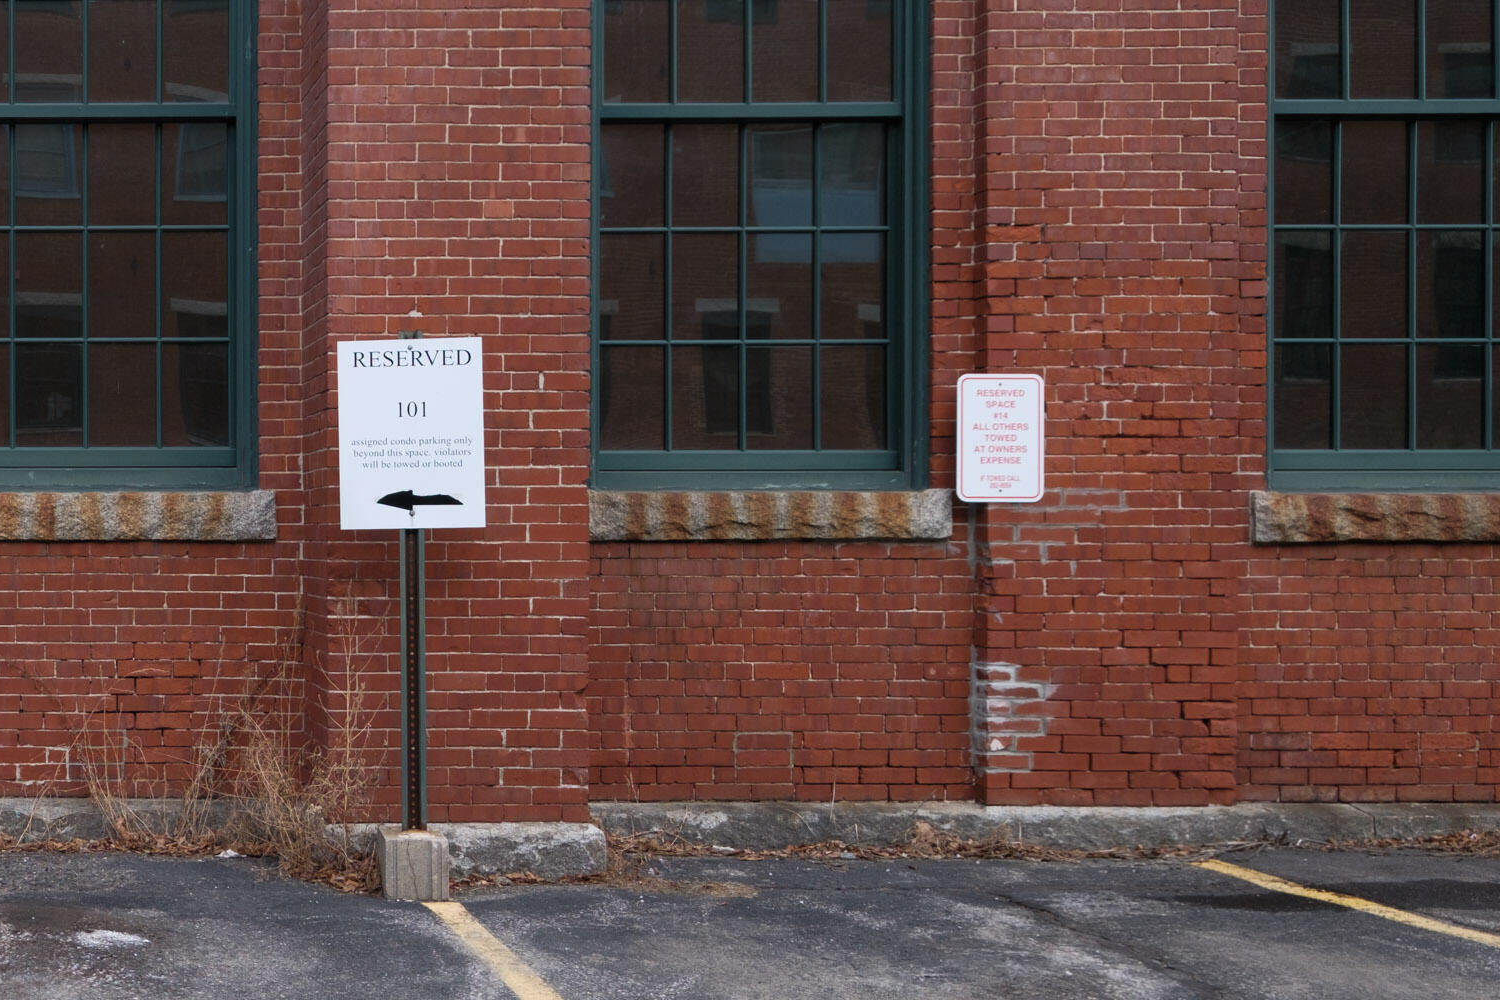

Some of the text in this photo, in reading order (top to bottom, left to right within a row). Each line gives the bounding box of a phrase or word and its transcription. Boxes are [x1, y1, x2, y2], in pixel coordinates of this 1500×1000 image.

[353, 349, 472, 368] RESERVED
[976, 389, 1026, 397] RESERVED
[985, 400, 1016, 408] SPACE
[397, 401, 428, 418] 101
[972, 423, 1029, 431] ALL OTHERS
[351, 436, 473, 448] assigned condo parking only
[984, 434, 1018, 442] TOWED
[973, 445, 1028, 453] AT OWNERS
[353, 449, 385, 459] beyond
[387, 449, 403, 457] this
[434, 448, 472, 456] violators
[362, 460, 379, 469] will
[381, 460, 391, 468] be
[393, 460, 420, 468] towed
[433, 459, 463, 468] booted
[980, 456, 1022, 464] EXPENSE
